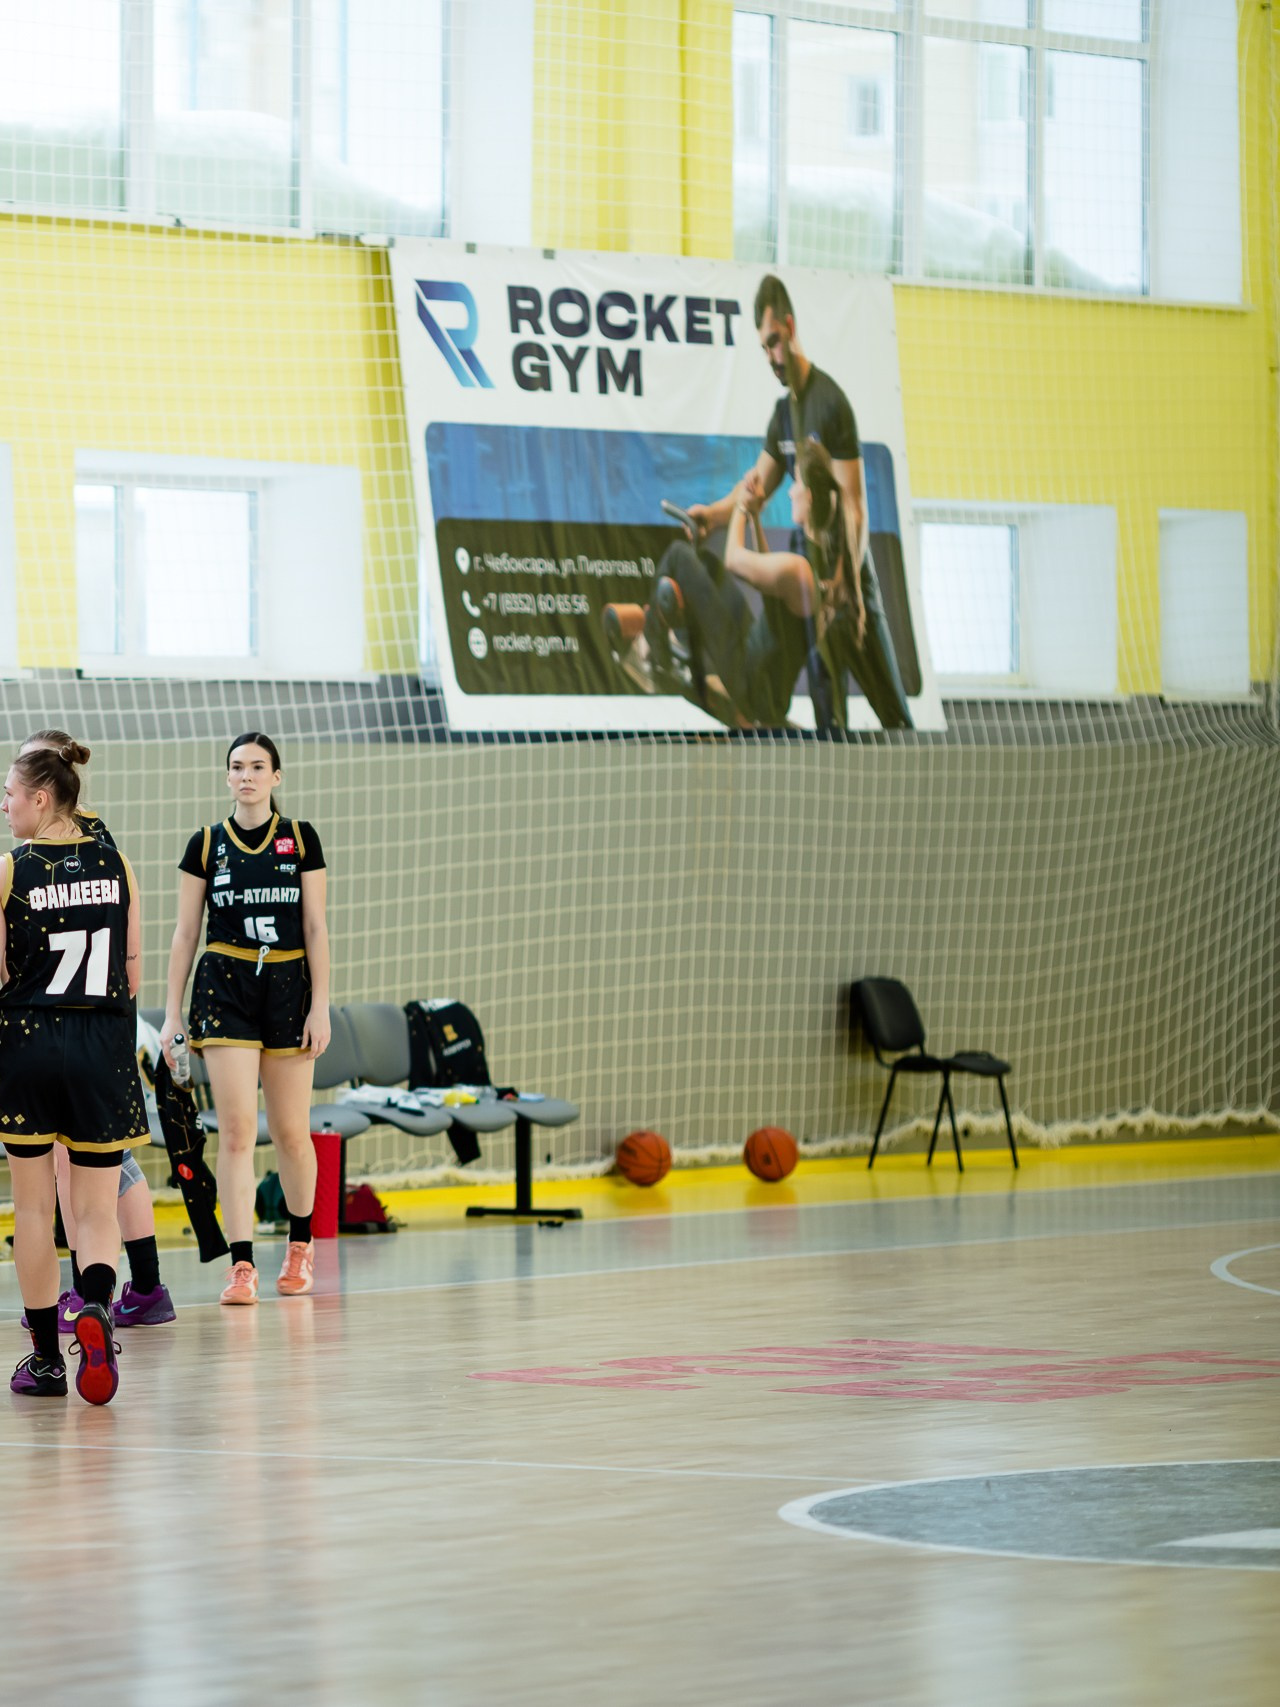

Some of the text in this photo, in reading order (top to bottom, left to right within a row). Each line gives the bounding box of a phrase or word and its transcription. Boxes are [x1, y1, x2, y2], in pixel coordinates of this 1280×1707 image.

[506, 284, 742, 346] ROCKET
[512, 341, 643, 397] GYM
[29, 879, 120, 911] ФАНДЕЕВА
[244, 916, 279, 943] 16
[45, 927, 111, 996] 71
